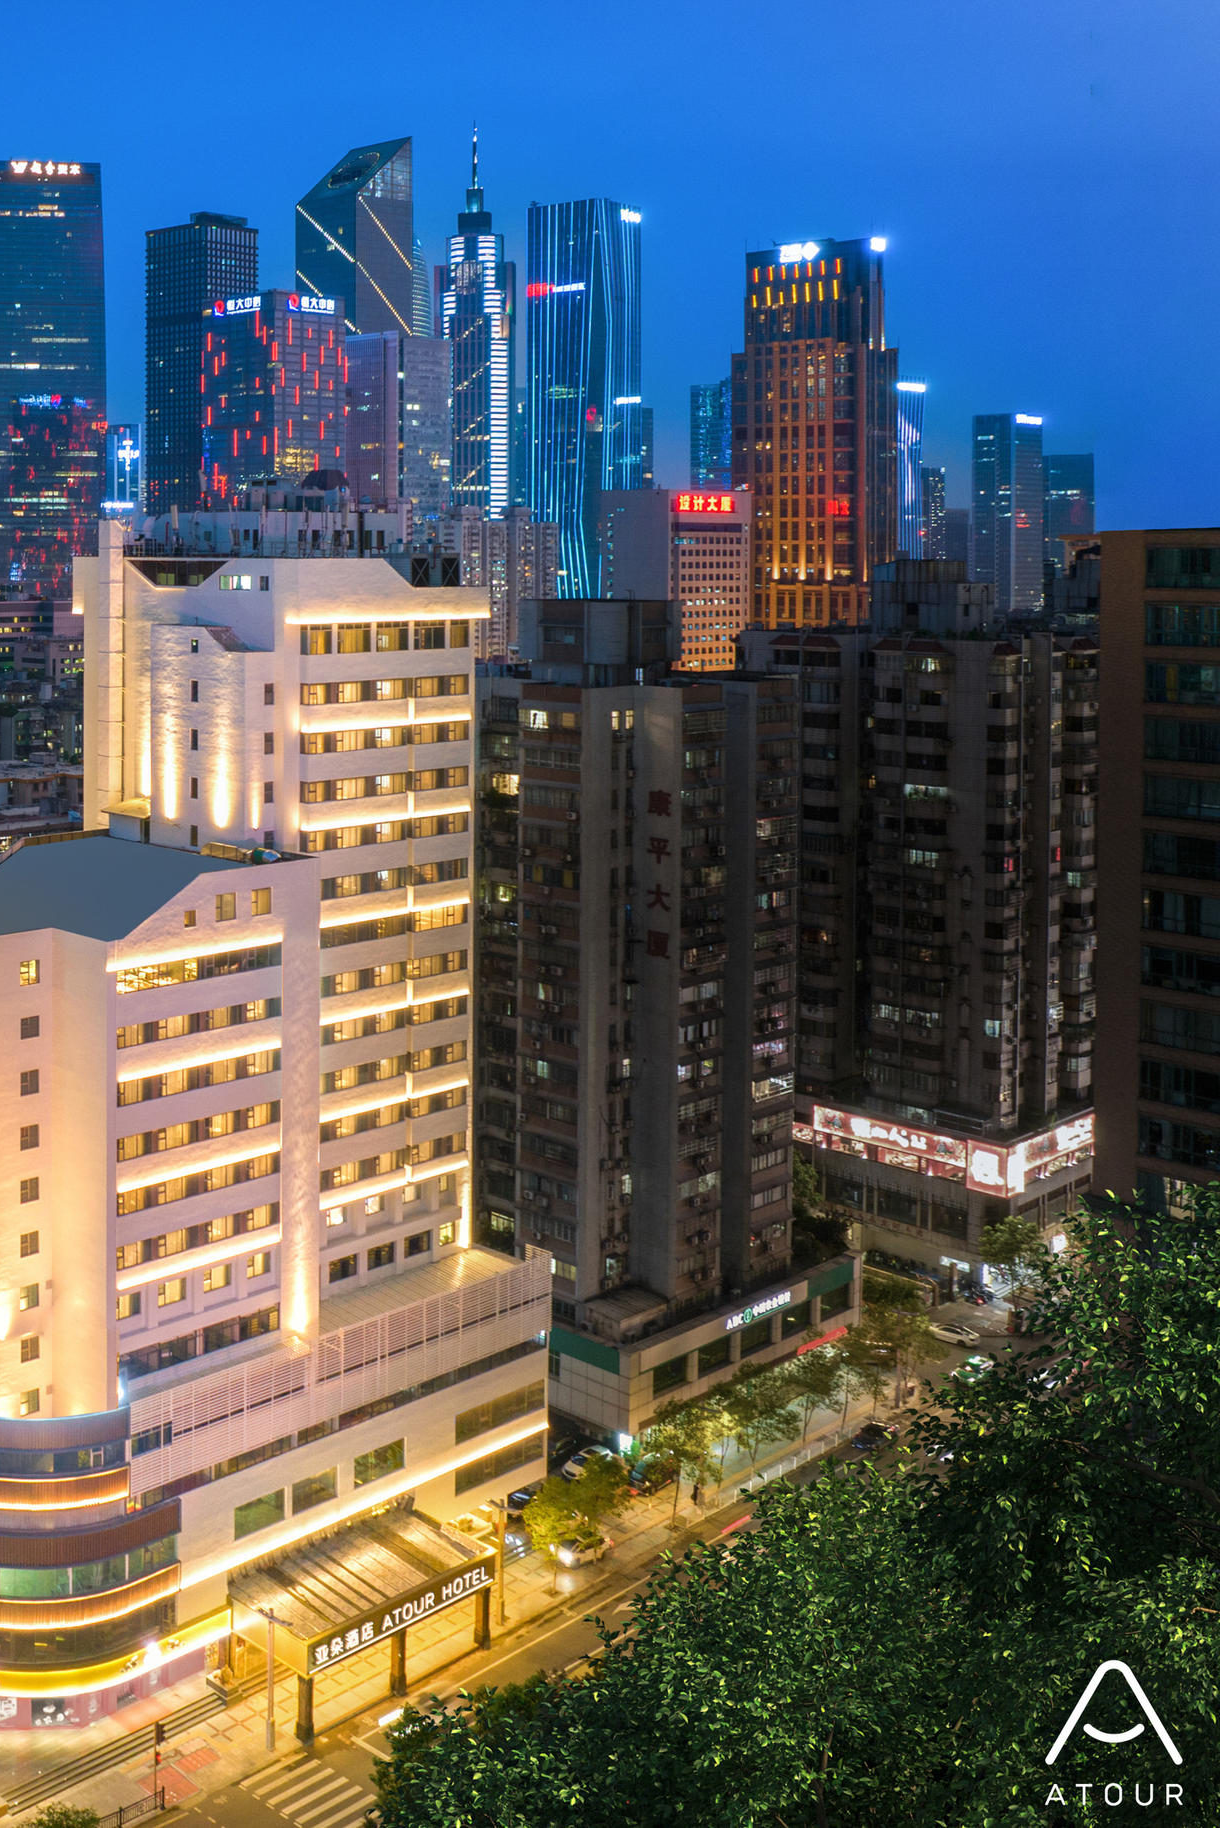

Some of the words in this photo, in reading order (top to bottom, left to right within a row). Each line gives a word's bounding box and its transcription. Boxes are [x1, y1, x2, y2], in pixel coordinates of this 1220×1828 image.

[679, 495, 732, 511] 设计大厦
[725, 1313, 745, 1330] ABC
[315, 1621, 374, 1665] 亚朵酒店
[382, 1592, 435, 1631] ATOUR
[442, 1566, 490, 1601] HOTEL
